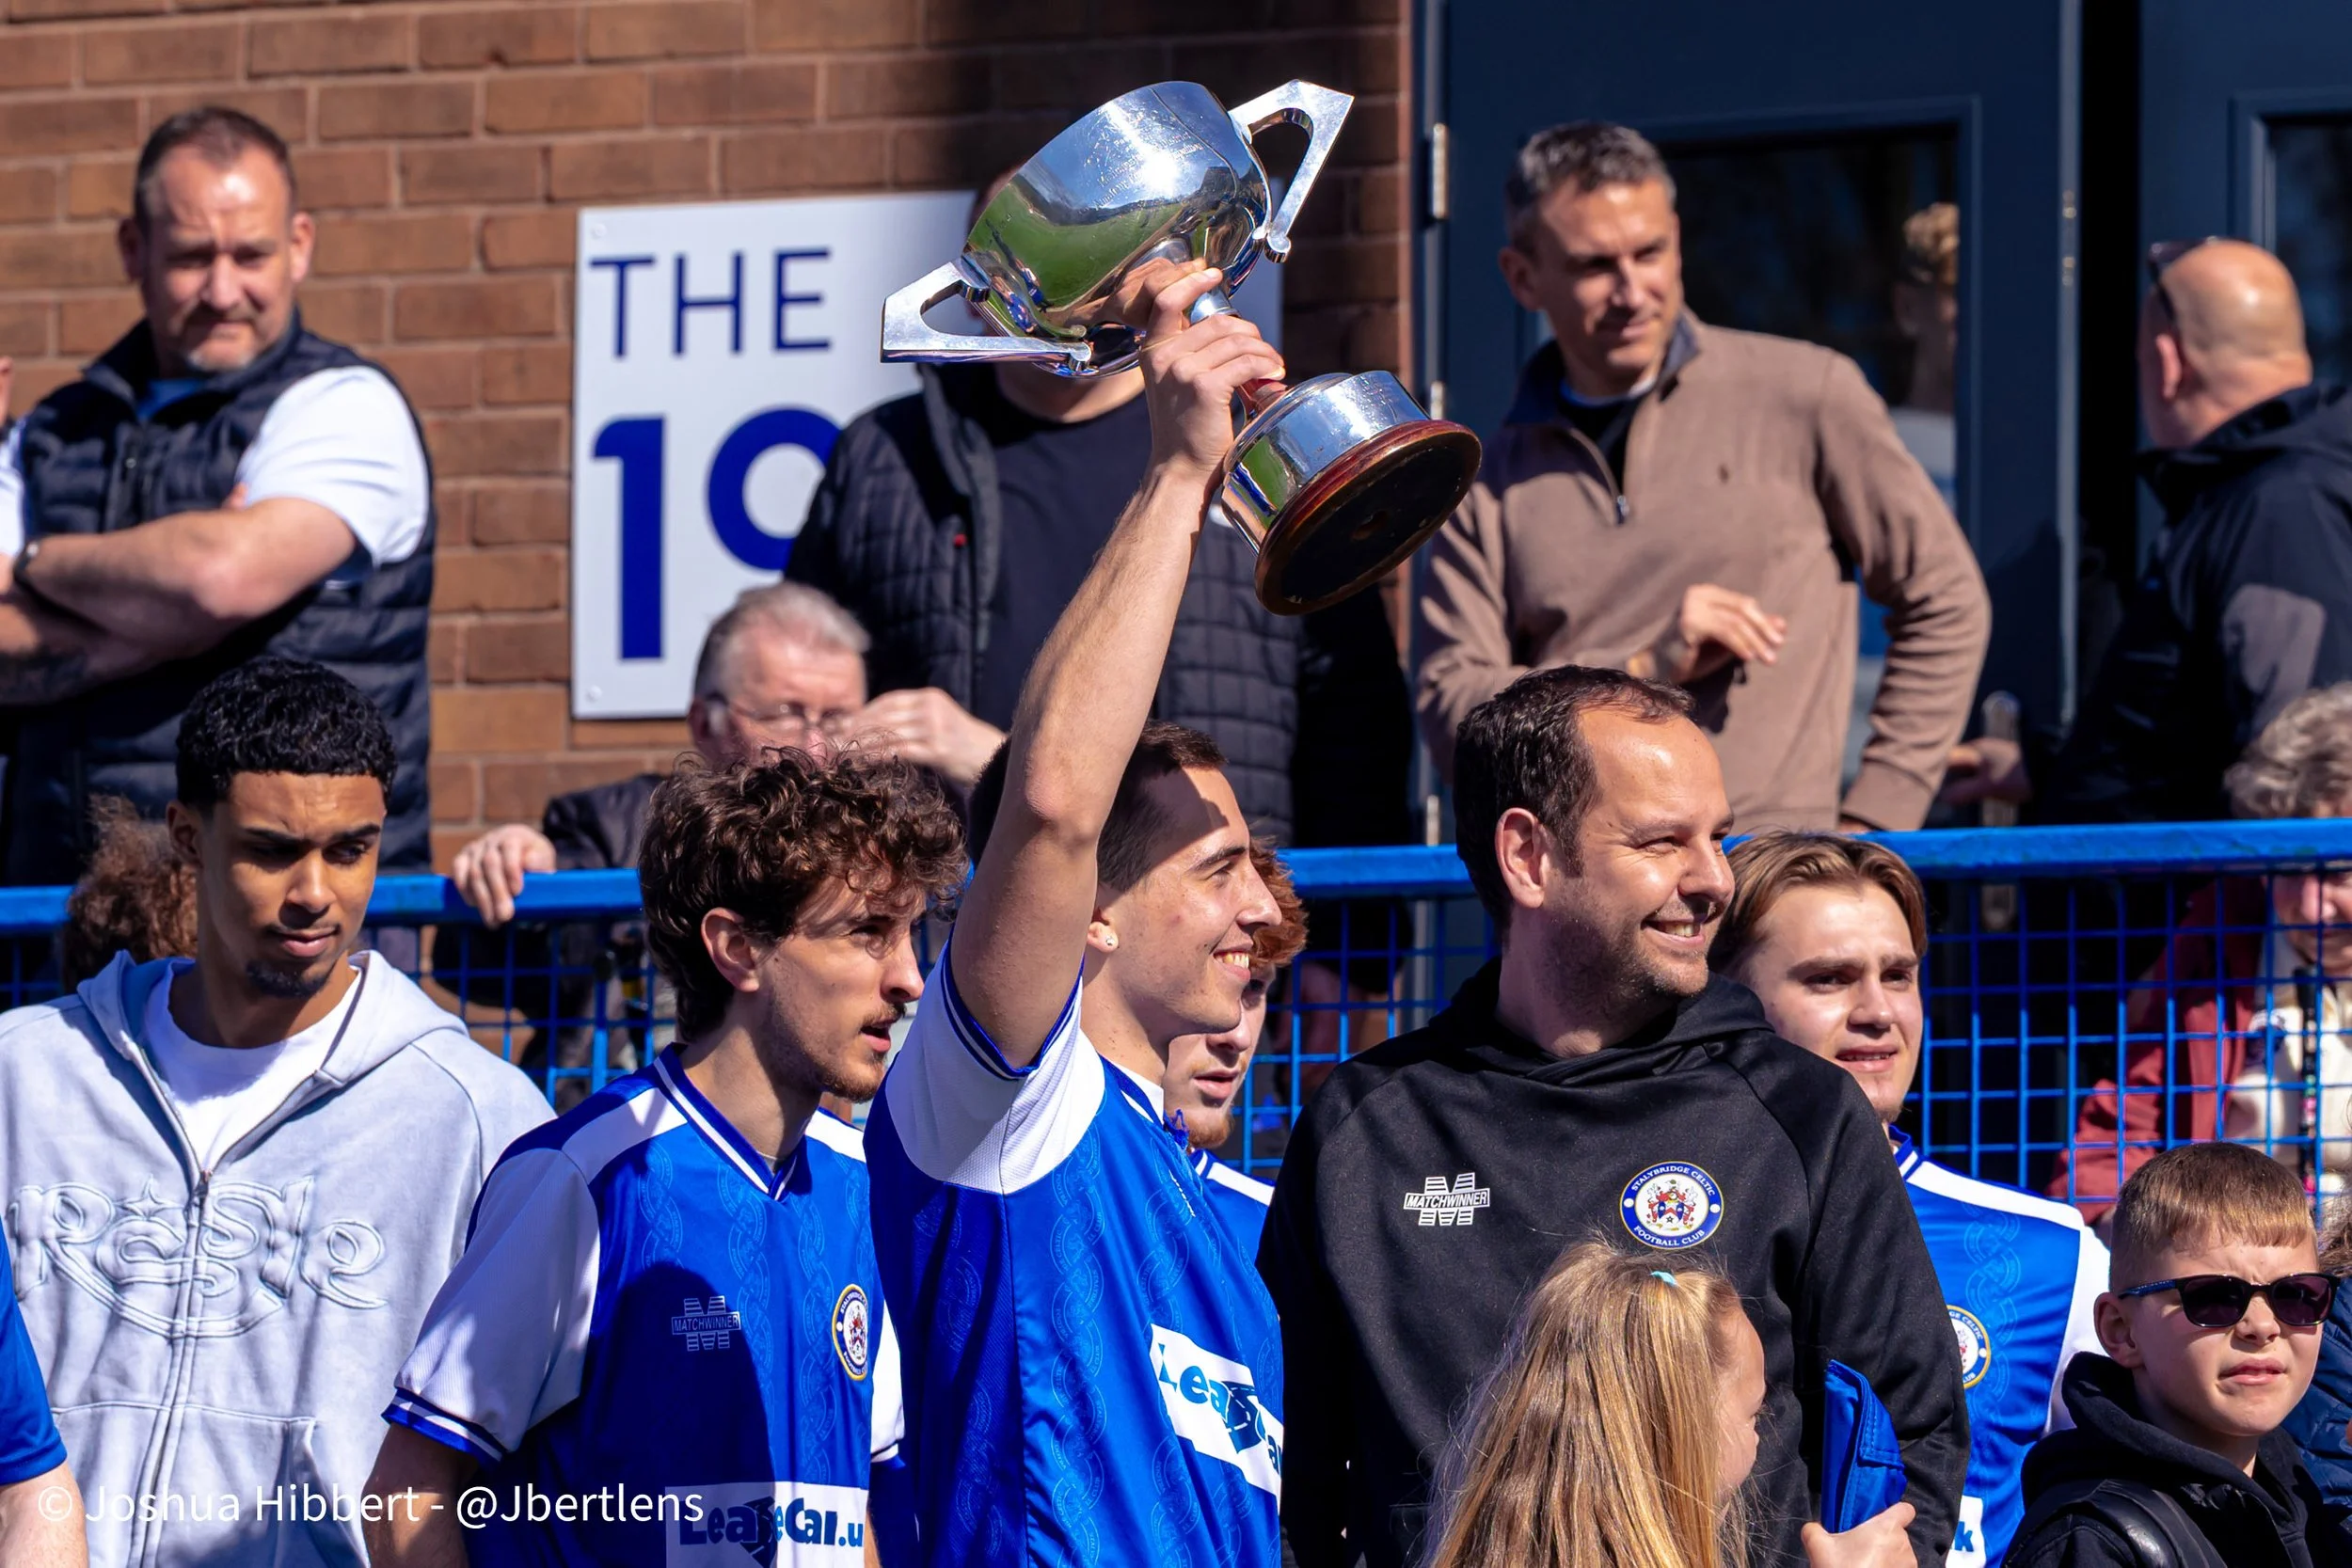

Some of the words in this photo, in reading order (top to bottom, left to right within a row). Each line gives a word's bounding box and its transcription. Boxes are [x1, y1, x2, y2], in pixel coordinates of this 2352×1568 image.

[588, 246, 833, 360] THE
[1631, 1164, 1690, 1192] STALYBRIDGE
[1691, 1170, 1716, 1196] CELTIC
[1406, 1190, 1487, 1209] MATCHWINNER
[1634, 1225, 1680, 1246] FOOTBALL
[1681, 1229, 1706, 1244] CLUB
[674, 1313, 739, 1332] MATCHWINNER
